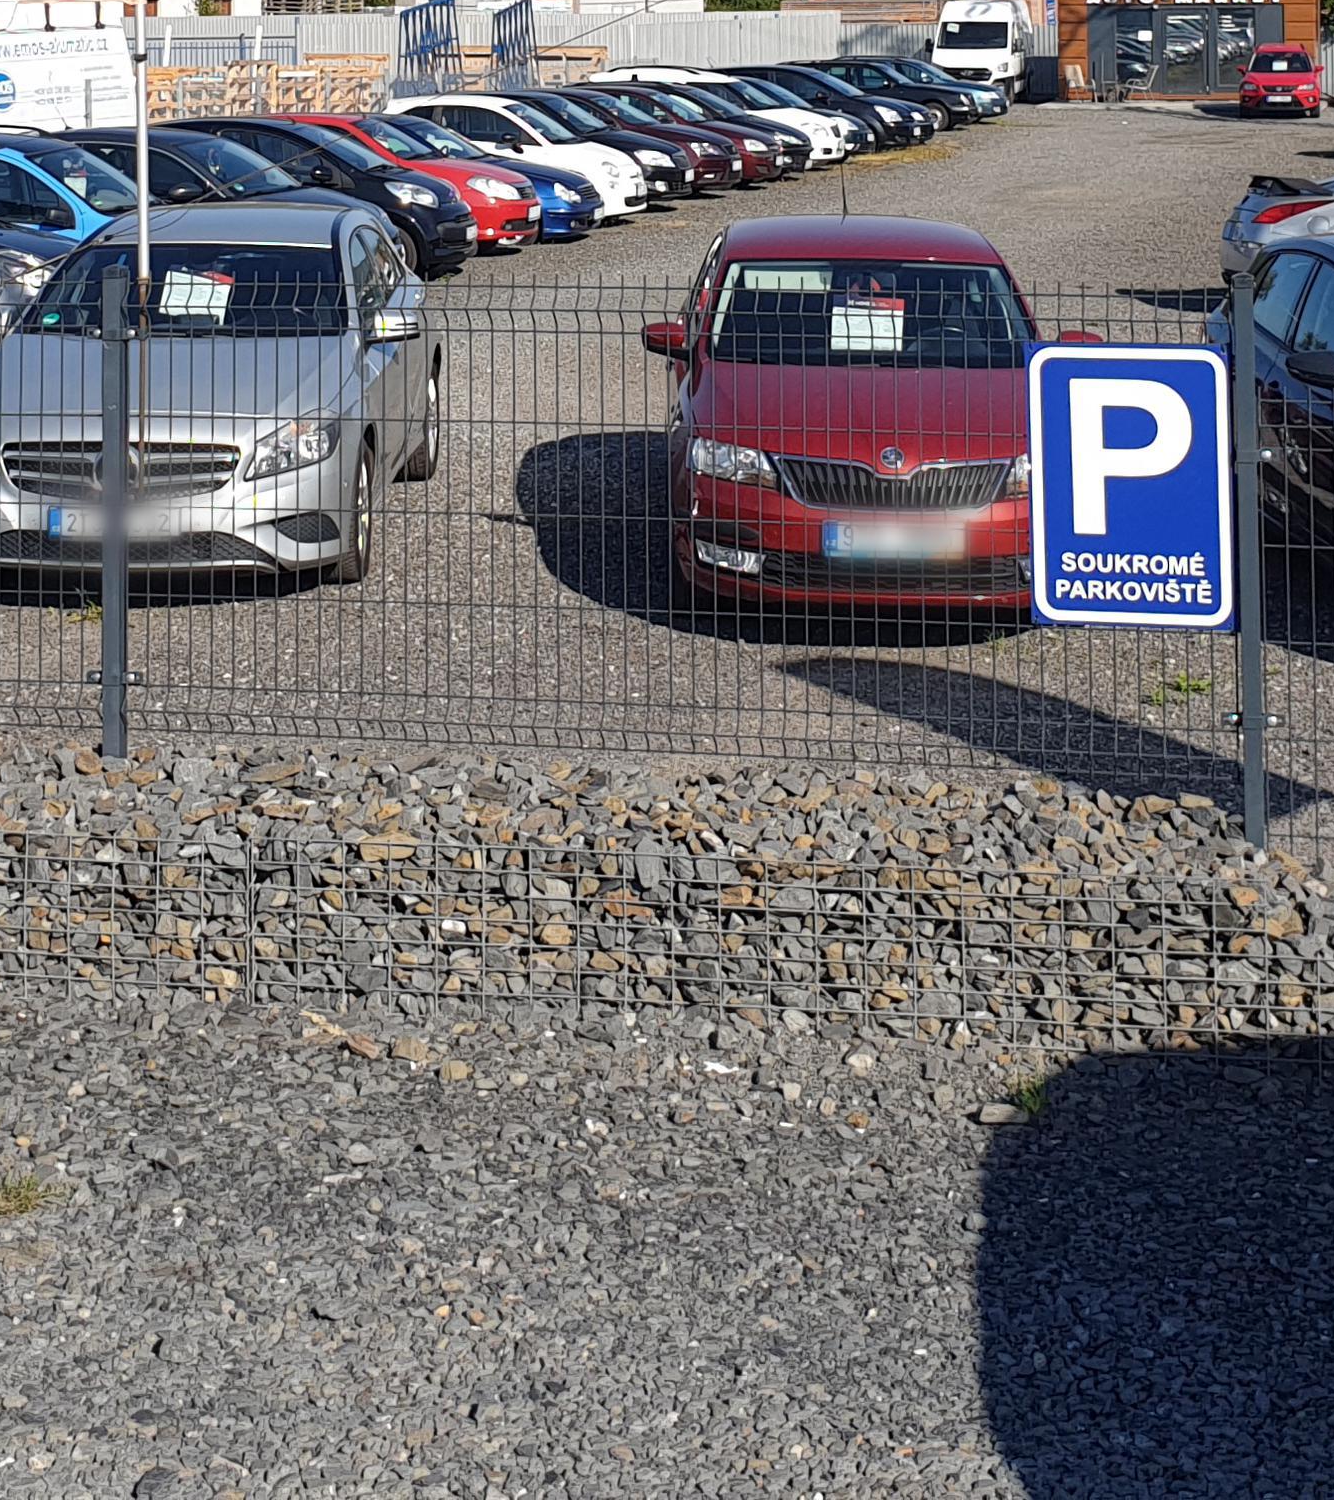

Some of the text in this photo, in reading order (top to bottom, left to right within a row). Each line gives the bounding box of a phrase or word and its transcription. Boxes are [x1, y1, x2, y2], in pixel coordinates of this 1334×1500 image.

[1068, 377, 1193, 535] P
[1061, 551, 1206, 577] SOUKROMÉ
[1055, 578, 1213, 604] PARKOVIŠTĚ
